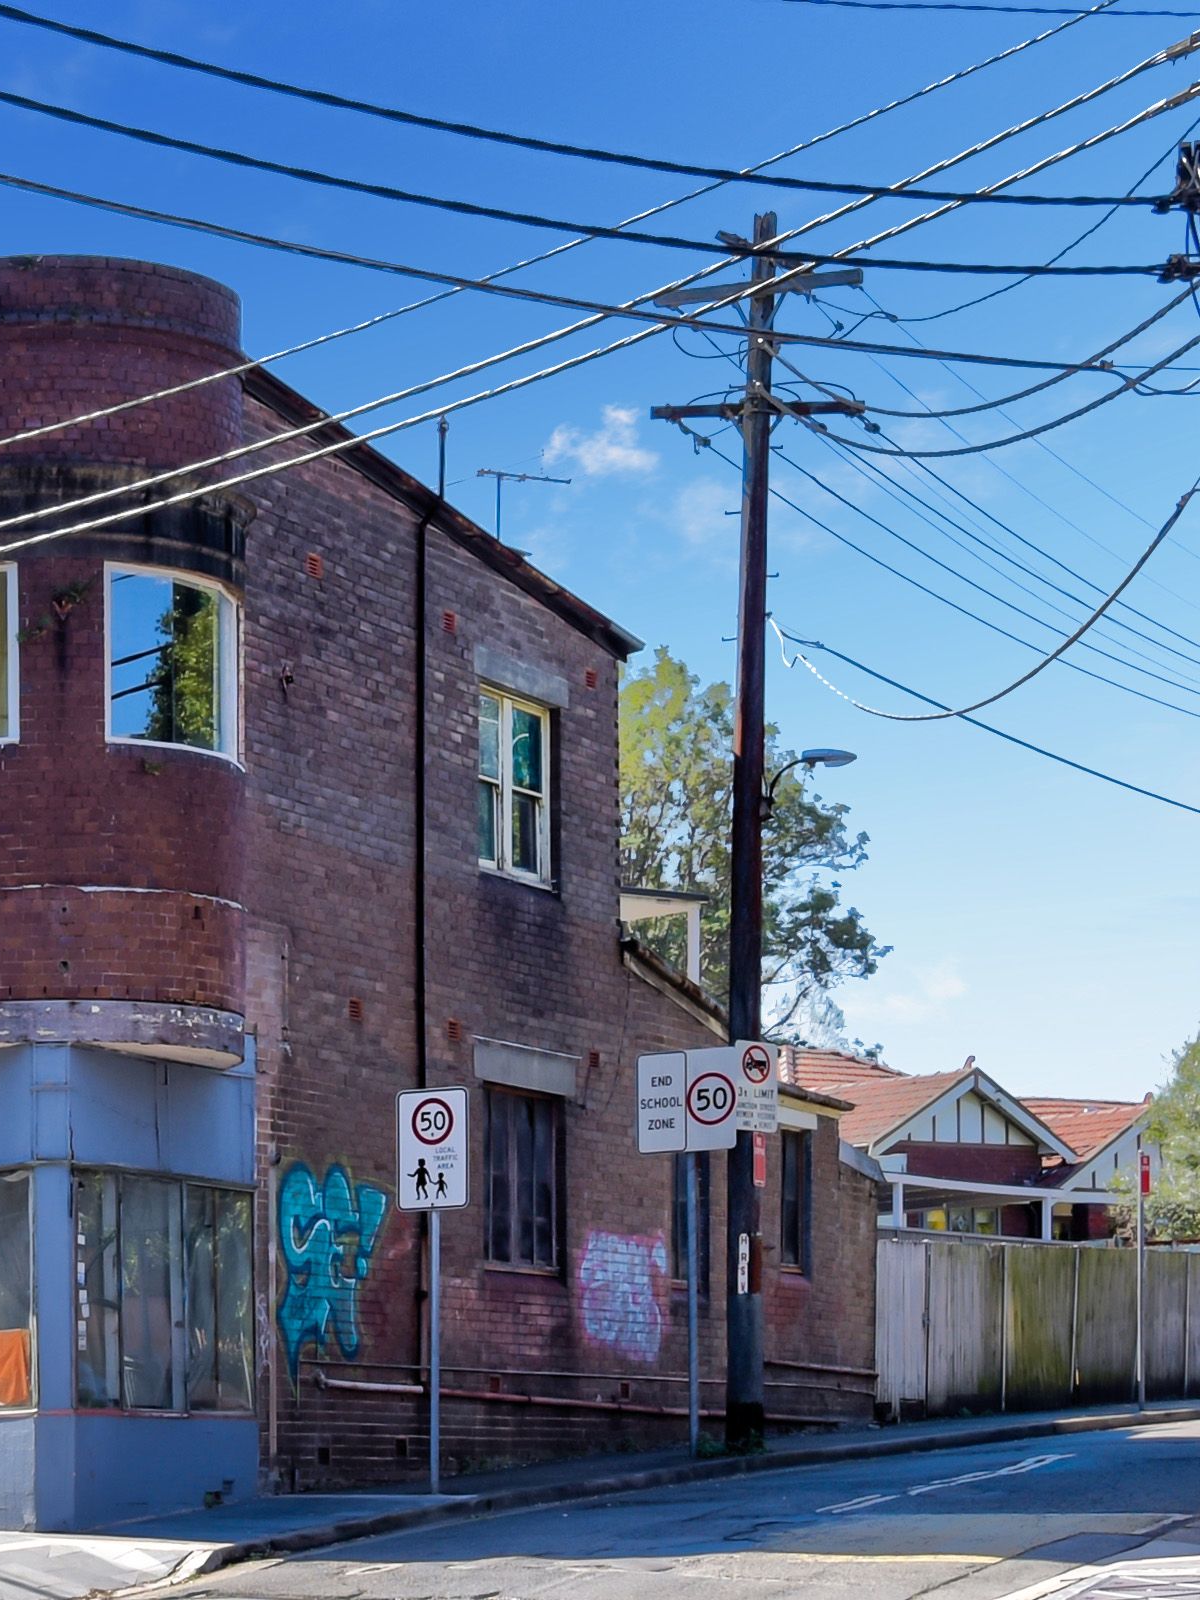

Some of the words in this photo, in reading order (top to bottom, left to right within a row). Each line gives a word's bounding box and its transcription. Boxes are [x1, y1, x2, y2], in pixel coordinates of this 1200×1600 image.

[651, 1075, 673, 1088] END
[696, 1087, 728, 1112] 50
[753, 1088, 775, 1099] LIMIT
[640, 1096, 683, 1110] SCHOOL
[420, 1110, 446, 1132] 50
[647, 1118, 676, 1131] ZONE
[435, 1146, 456, 1154] LOCAL
